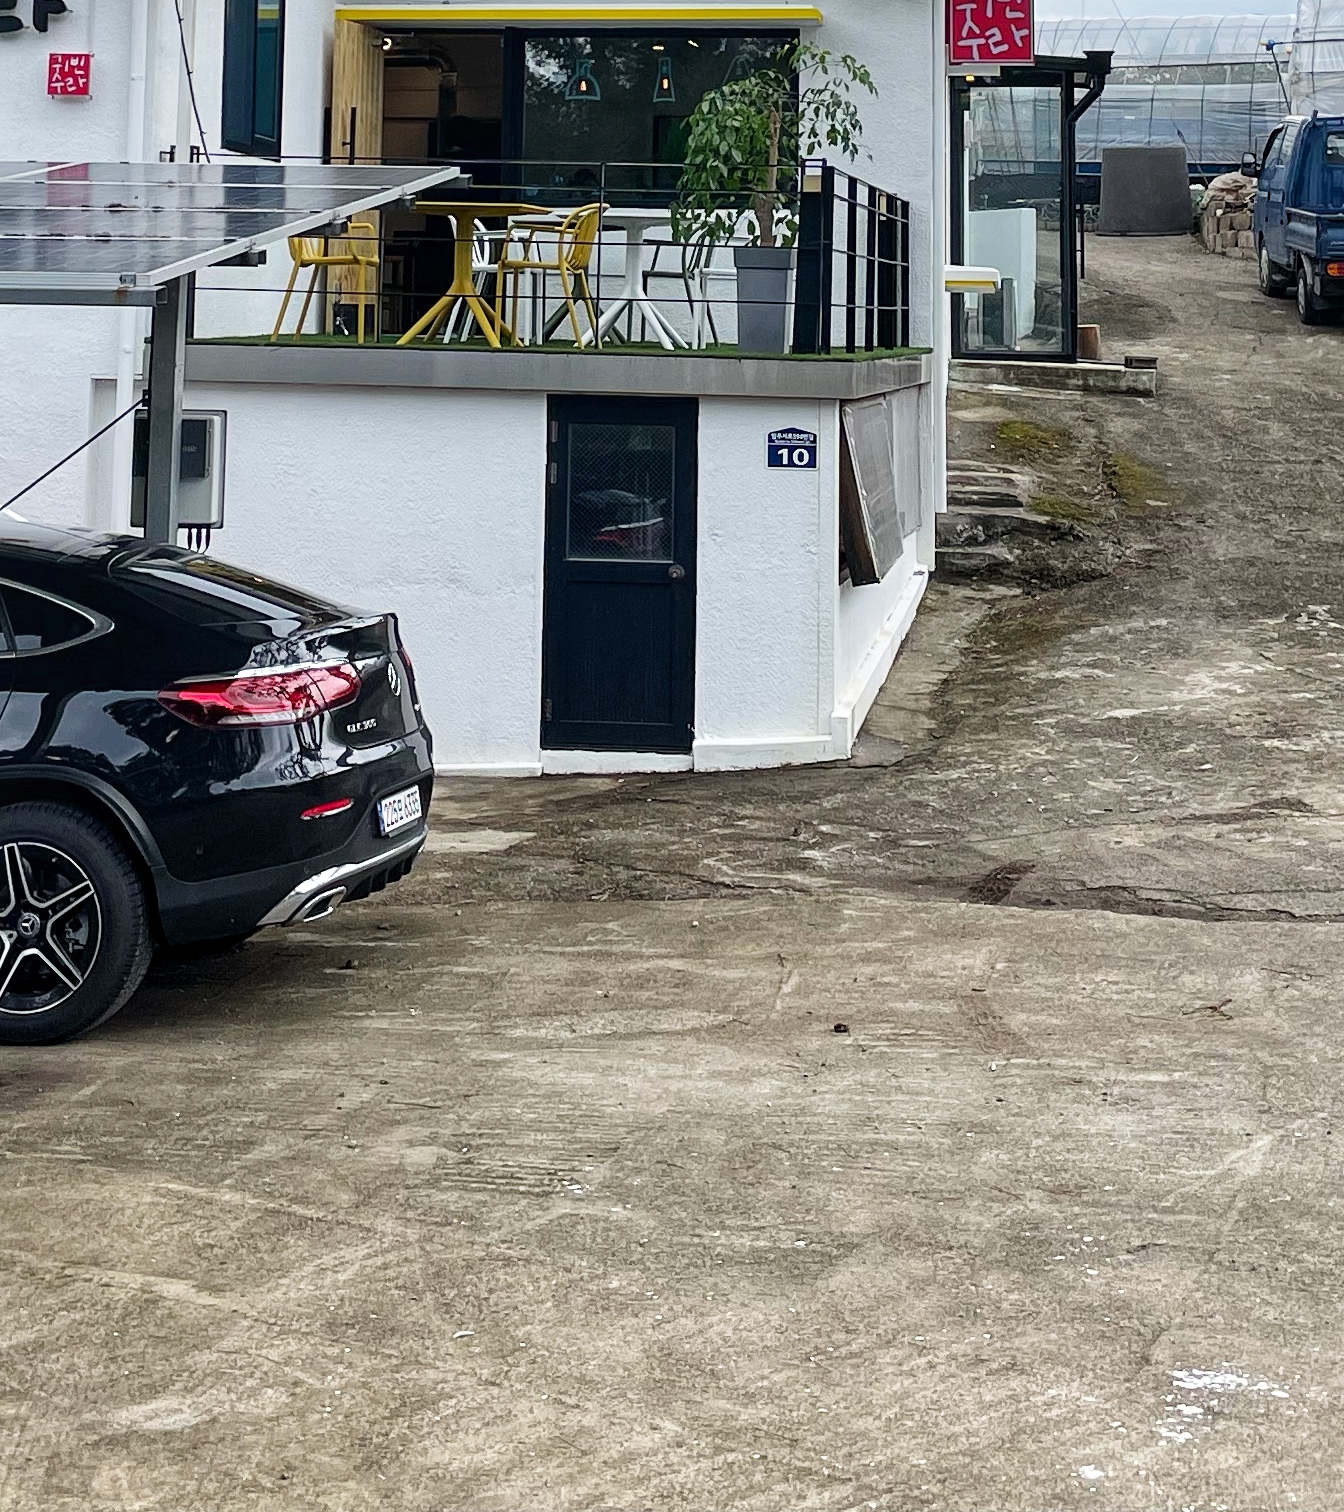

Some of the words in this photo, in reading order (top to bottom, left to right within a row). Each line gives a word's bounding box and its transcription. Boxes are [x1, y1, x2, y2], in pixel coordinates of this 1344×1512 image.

[956, 23, 1030, 61] 수라
[51, 55, 86, 75] 귀빈
[50, 73, 87, 94] 수라
[777, 448, 810, 466] 10
